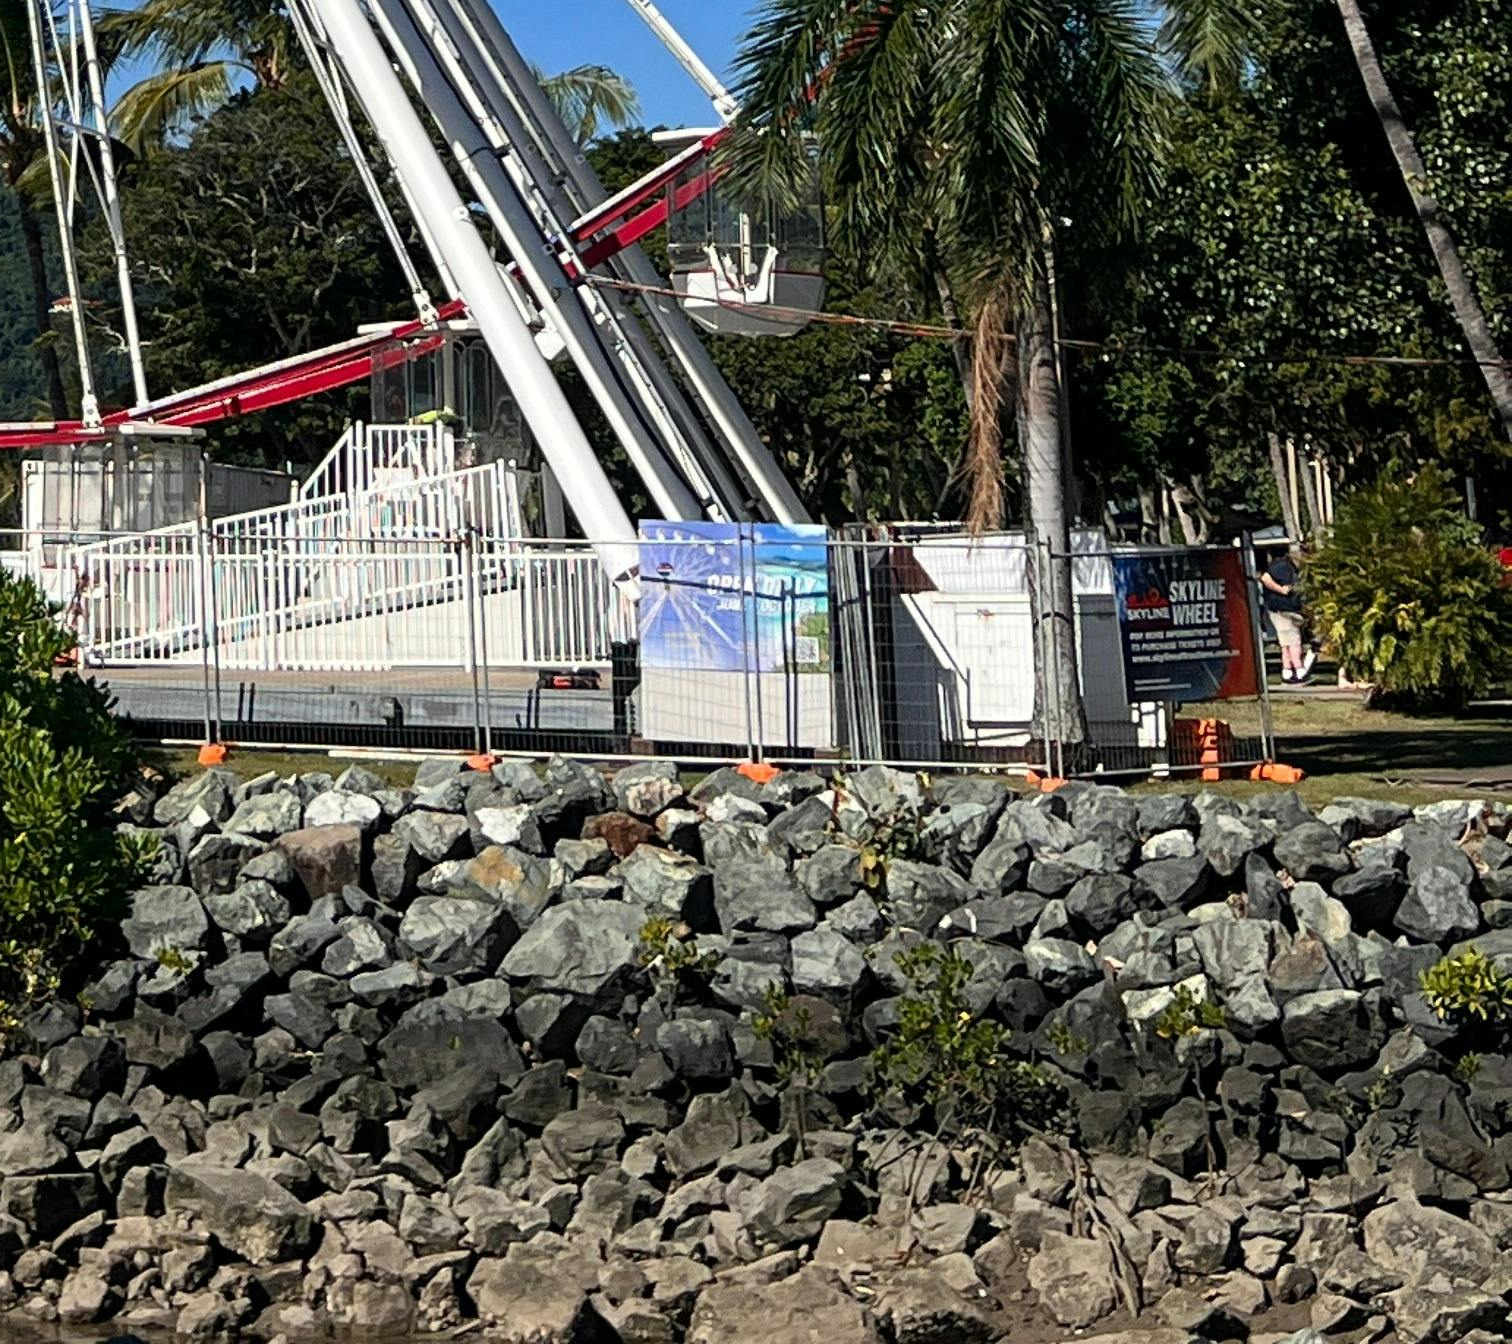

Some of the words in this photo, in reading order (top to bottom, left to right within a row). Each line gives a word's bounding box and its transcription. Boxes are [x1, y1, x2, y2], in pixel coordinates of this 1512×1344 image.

[1169, 578, 1226, 602] SKYLINE
[1127, 606, 1171, 621] SKYLINE
[1171, 602, 1220, 625] WHEEL
